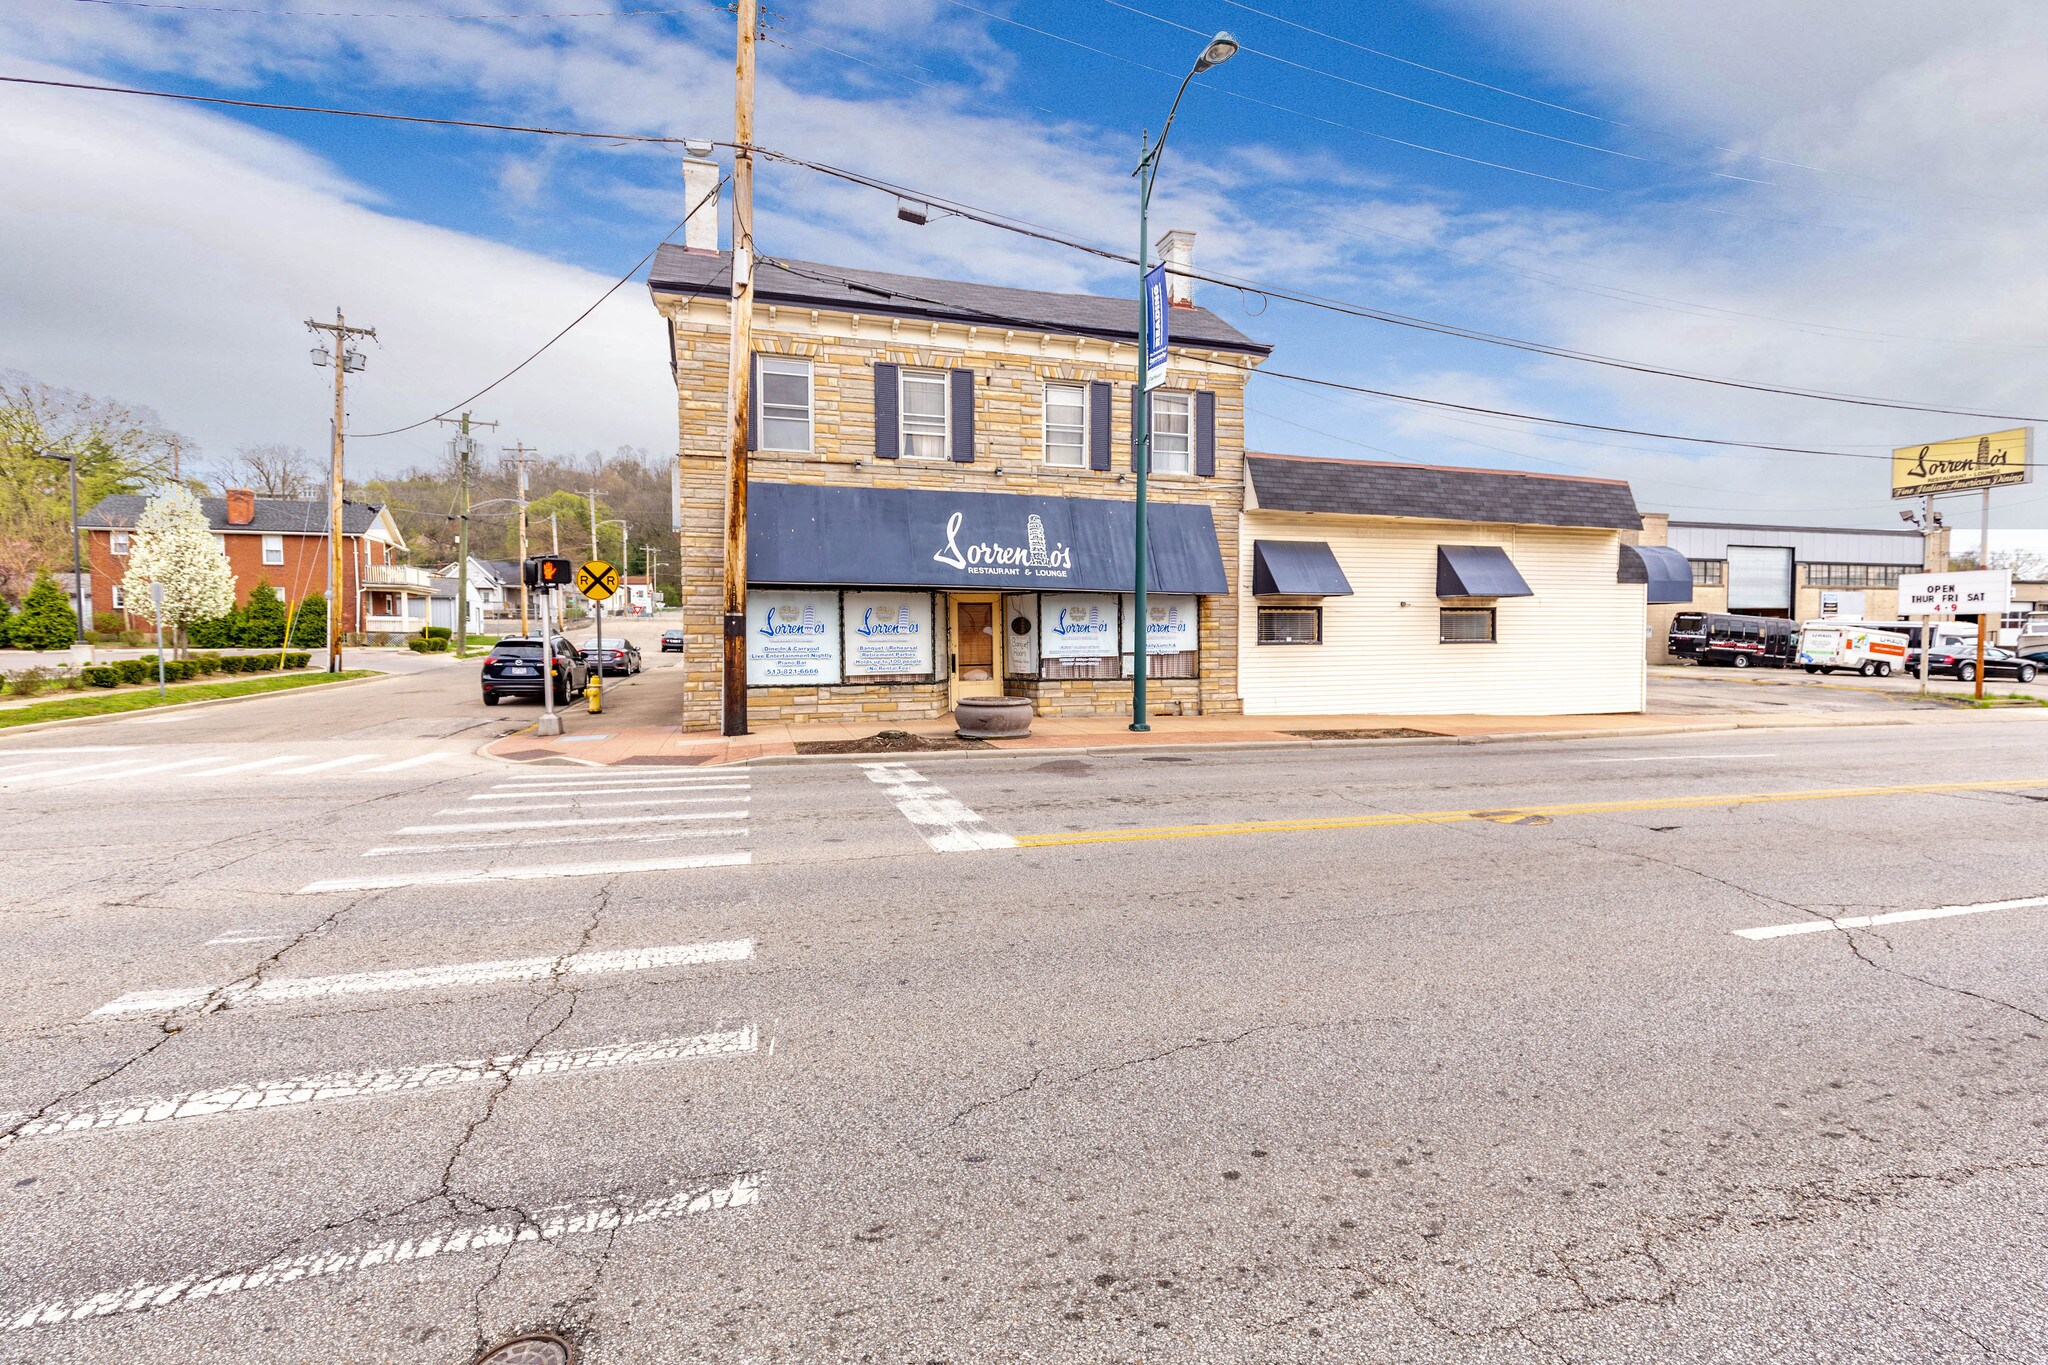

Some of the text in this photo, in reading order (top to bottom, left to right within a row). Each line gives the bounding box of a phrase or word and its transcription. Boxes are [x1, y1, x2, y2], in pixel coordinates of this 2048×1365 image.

[1973, 468, 2001, 478] LOUNGE
[968, 566, 1020, 575] RESTAURANT
[1035, 569, 1068, 578] LOUNGE
[580, 575, 615, 585] R R
[1927, 584, 1955, 593] OPEN
[1911, 592, 1985, 604] THUR FRI SAT
[1934, 604, 1941, 612] 4
[1951, 604, 1957, 612] 9
